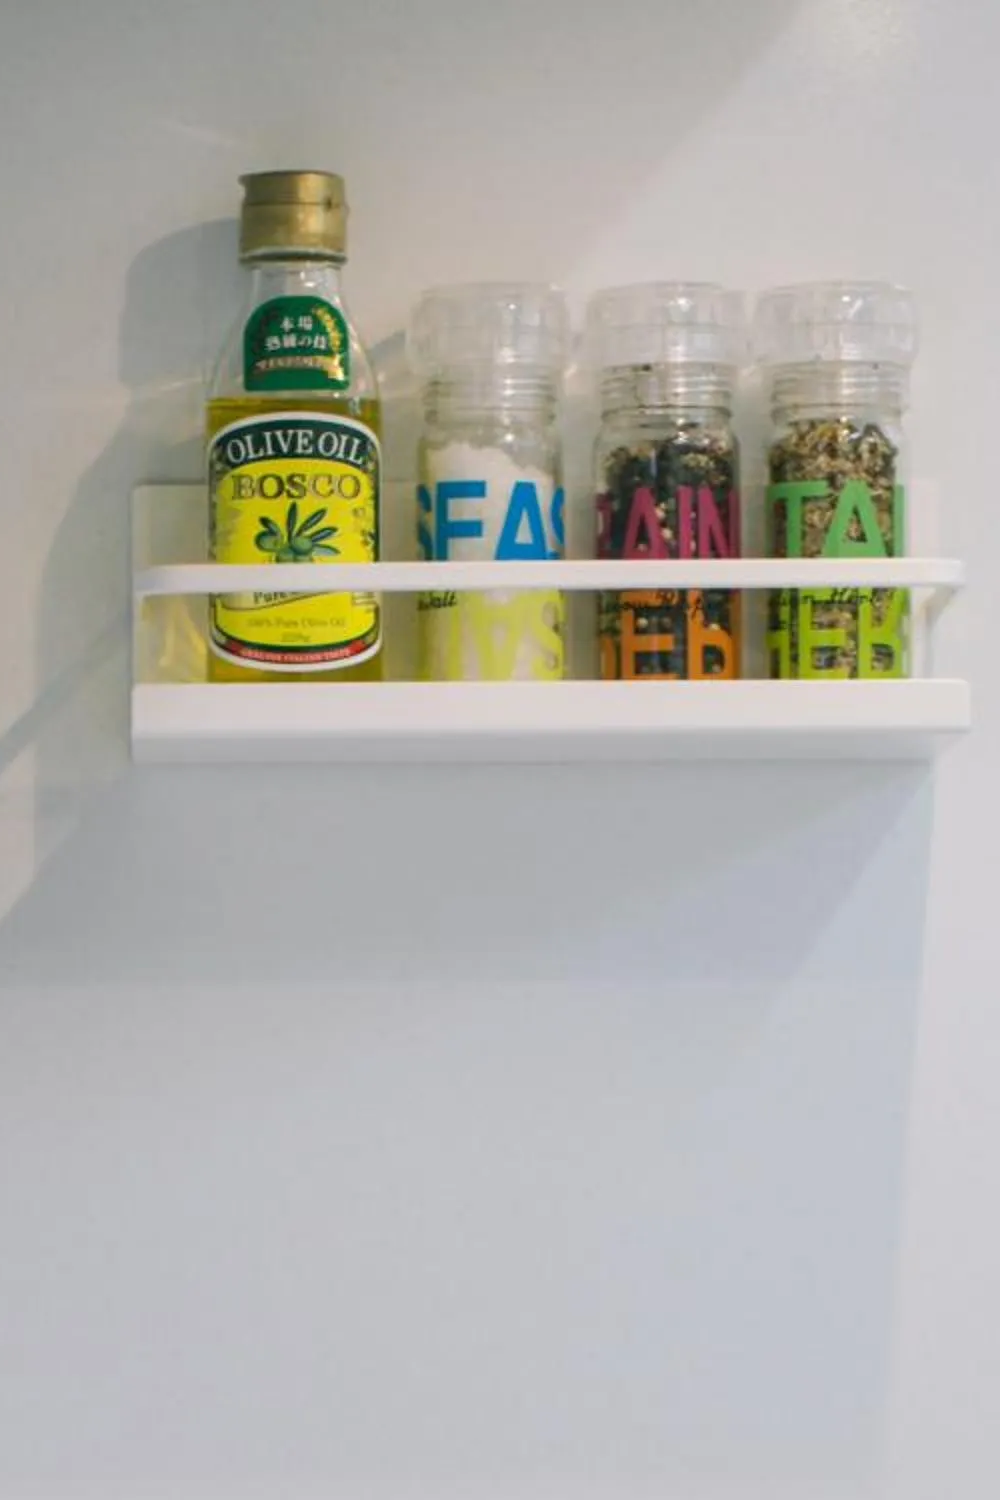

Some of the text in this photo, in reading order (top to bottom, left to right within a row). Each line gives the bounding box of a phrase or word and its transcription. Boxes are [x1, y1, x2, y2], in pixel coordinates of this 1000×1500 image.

[226, 429, 363, 465] OLIVE OIL
[231, 472, 362, 501] BOSCO
